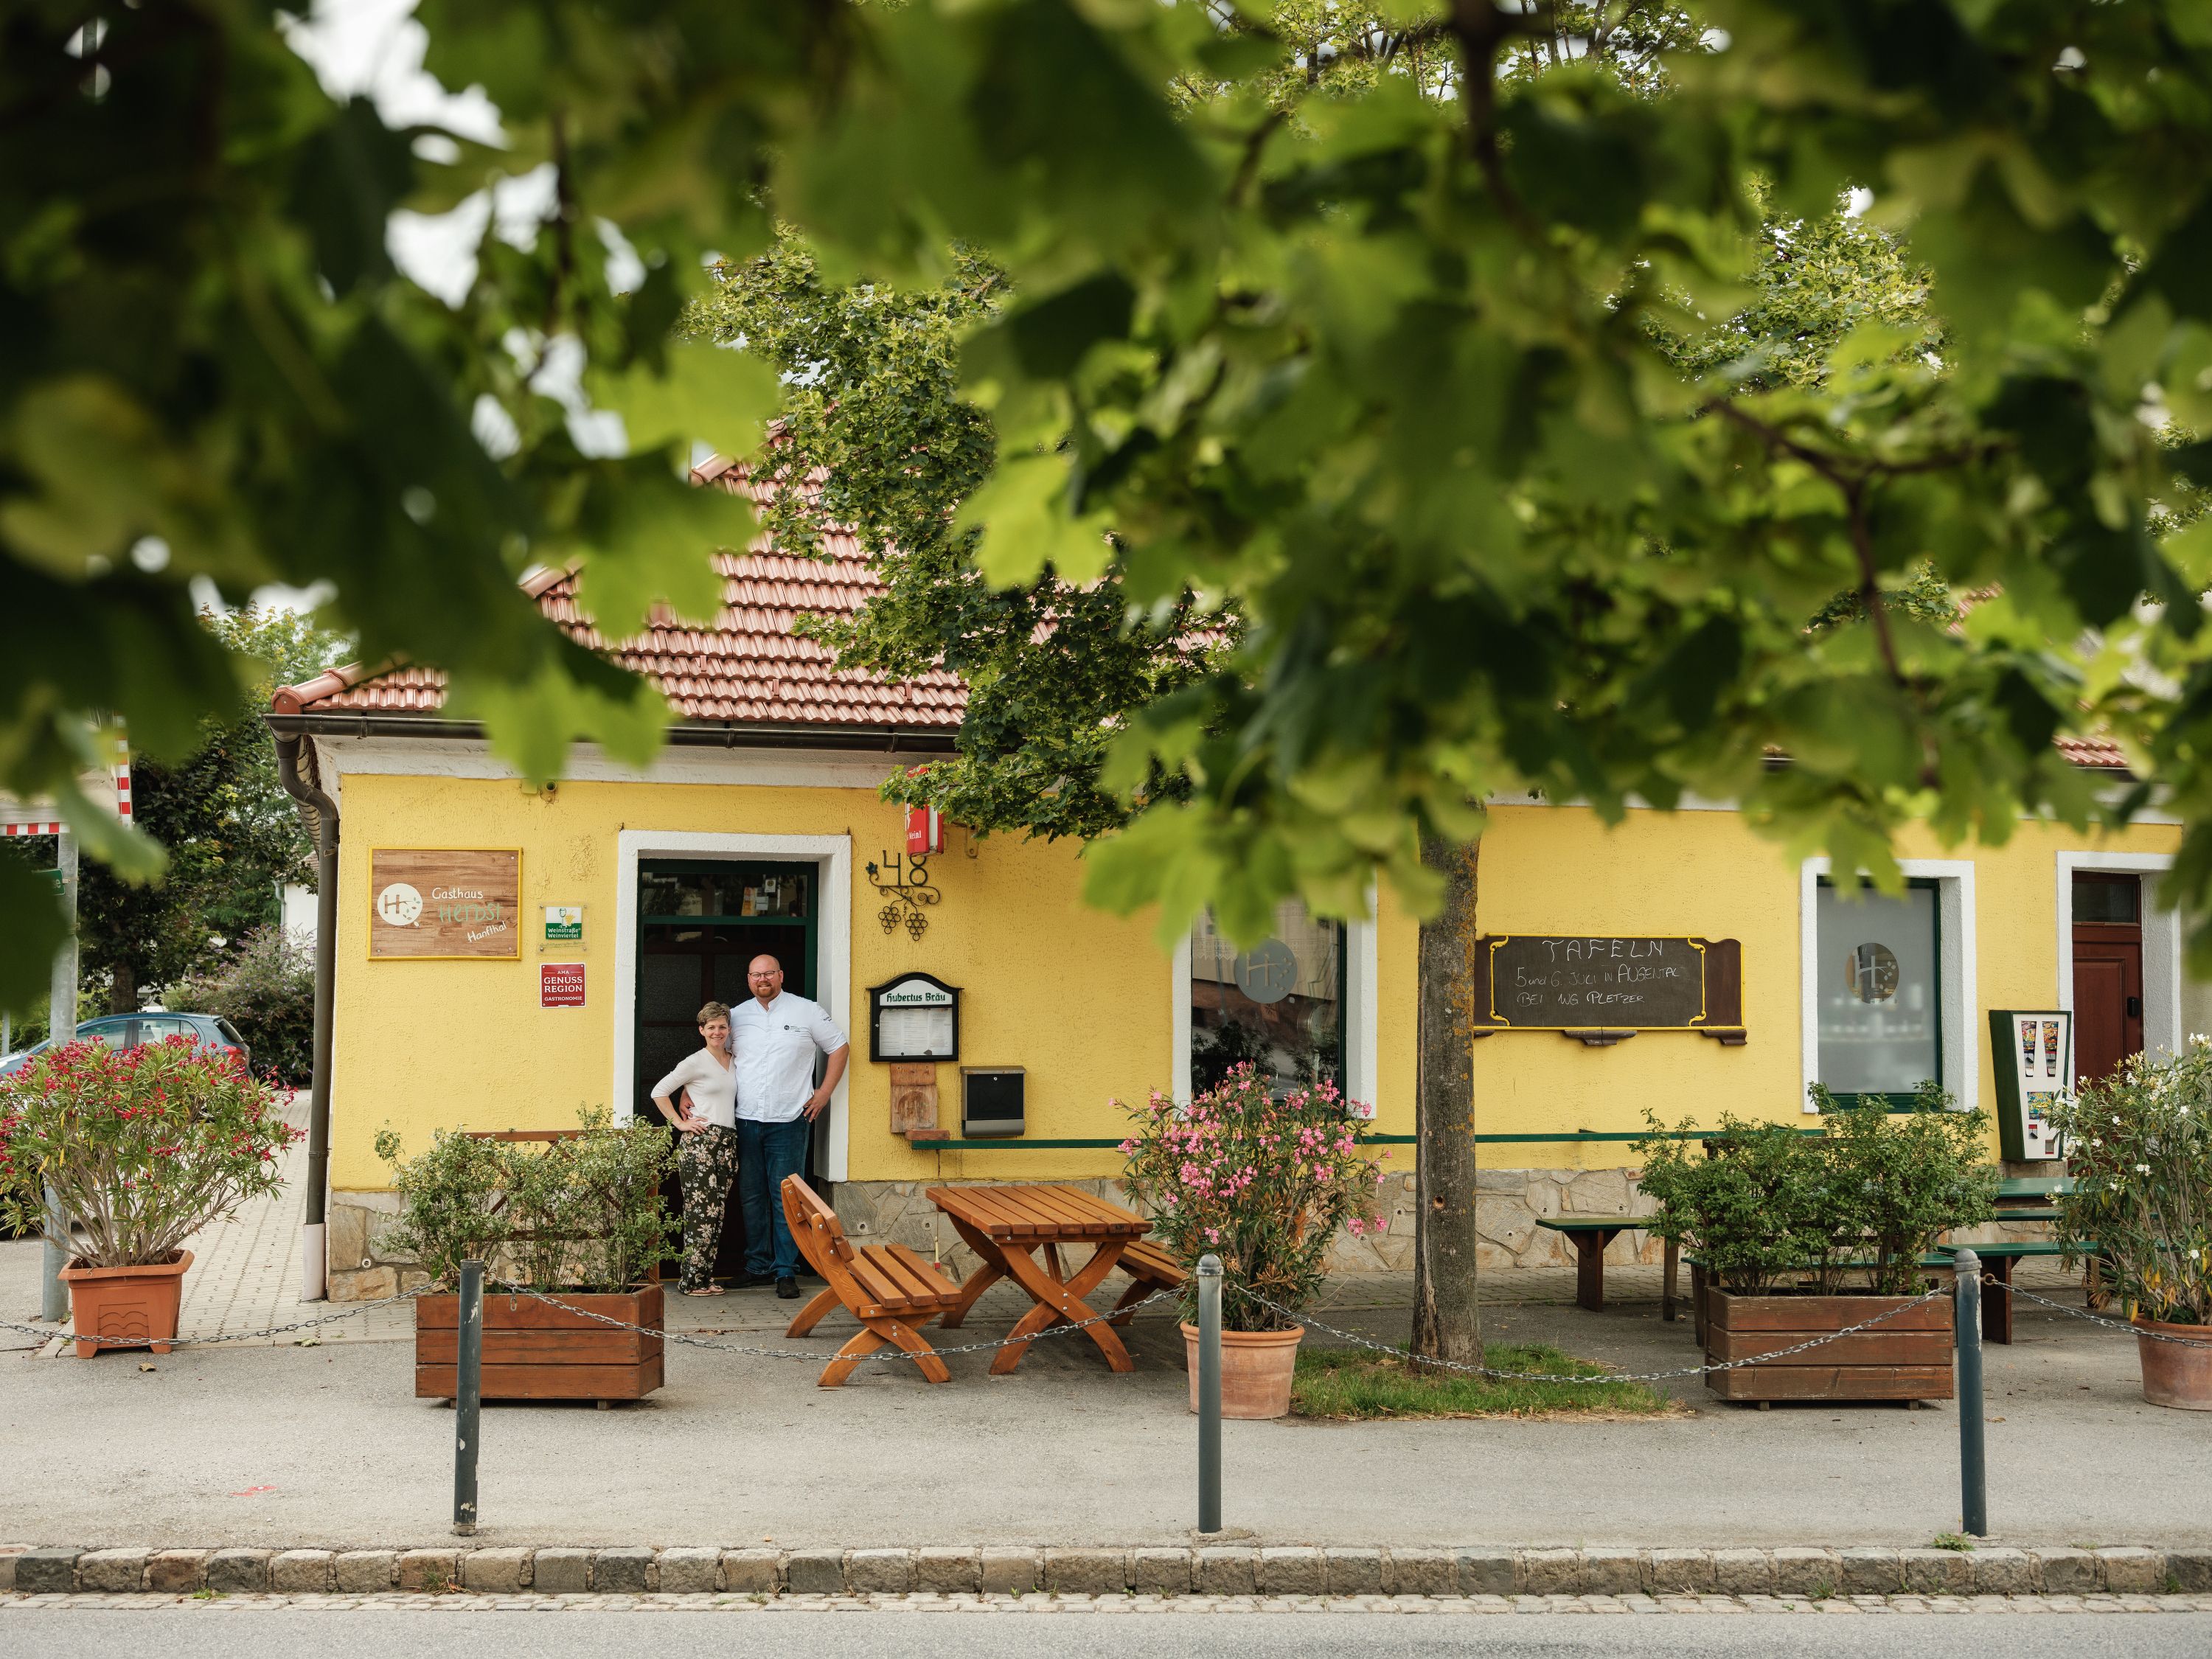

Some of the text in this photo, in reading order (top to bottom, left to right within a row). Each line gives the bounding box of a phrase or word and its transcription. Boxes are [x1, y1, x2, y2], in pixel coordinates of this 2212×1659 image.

[908, 830, 922, 841] Meinl
[883, 849, 928, 886] 48
[431, 887, 484, 900] Gasthaus
[439, 902, 504, 922] Herbst
[467, 920, 507, 943] Hanfthal
[1542, 939, 1662, 962] TAFELN
[543, 976, 582, 984] GENUSS
[1551, 970, 1563, 987] 6.
[1569, 972, 1597, 985] JULI
[886, 992, 946, 1003] Hubertus Bräu
[1517, 992, 1543, 1007] BEI
[1586, 991, 1645, 1004] PLETZER
